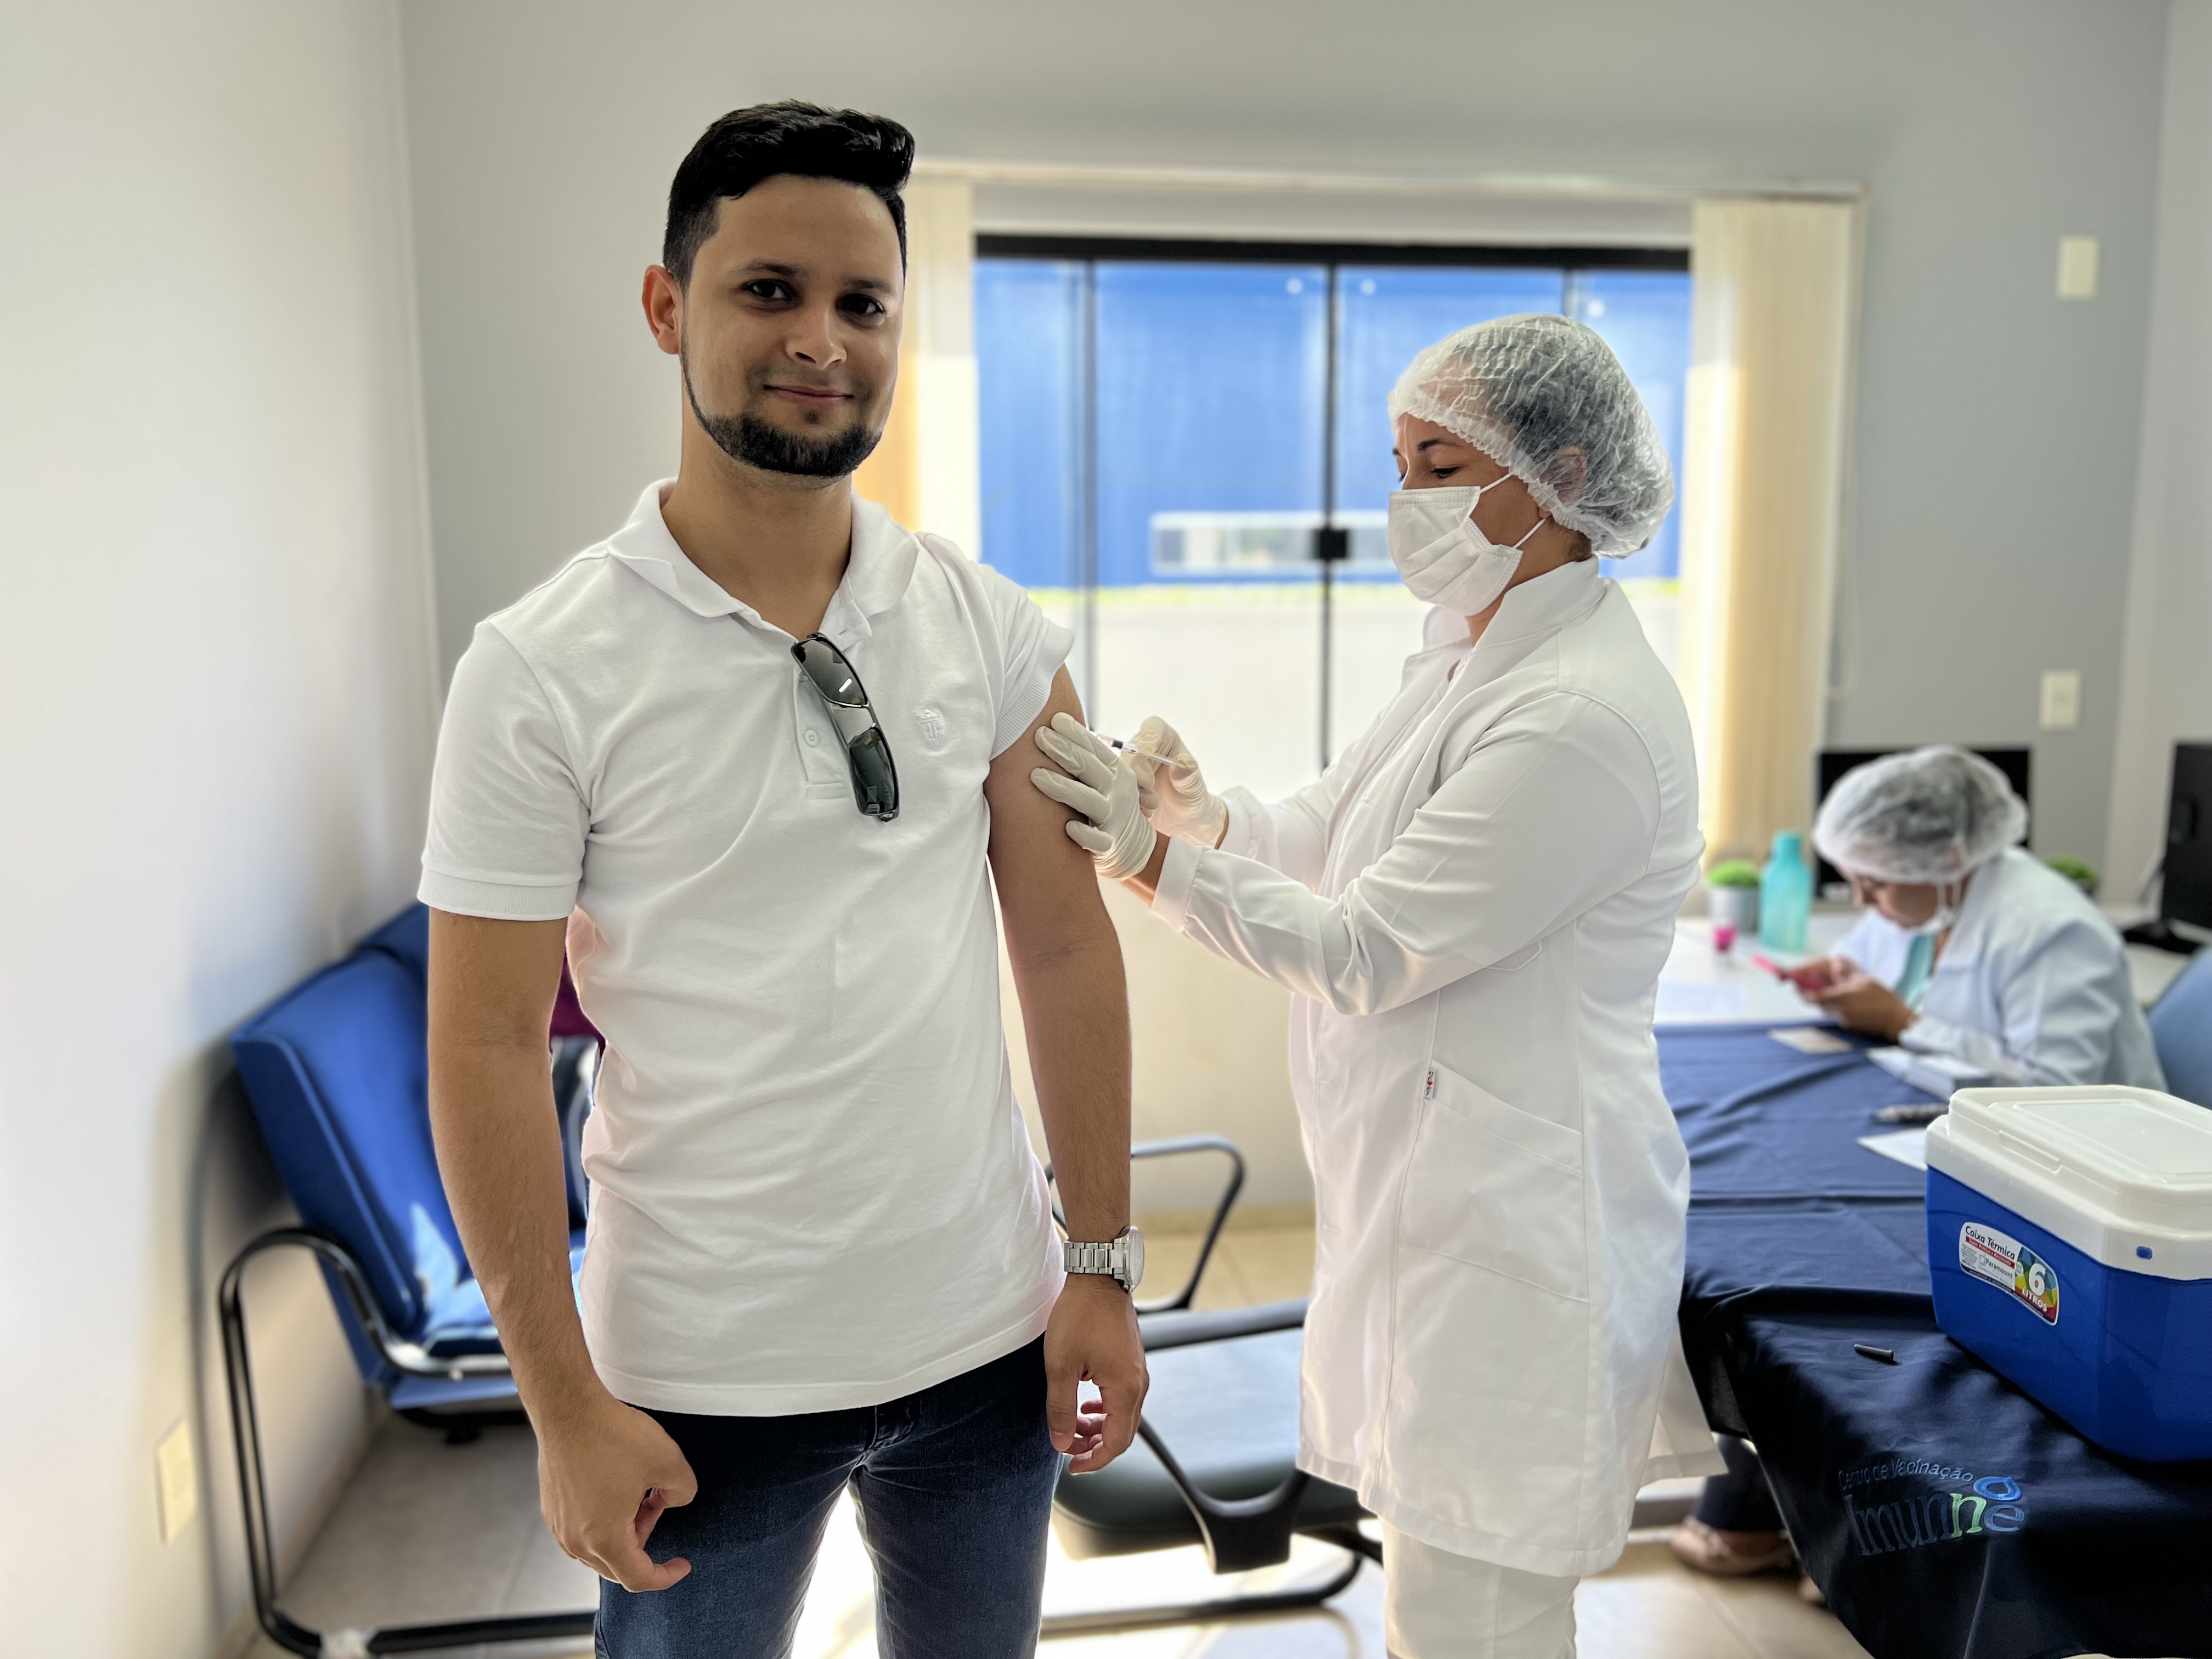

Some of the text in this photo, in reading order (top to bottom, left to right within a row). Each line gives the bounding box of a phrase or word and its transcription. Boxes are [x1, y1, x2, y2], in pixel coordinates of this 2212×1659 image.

[1966, 1226, 1985, 1243] Caixa
[1988, 1237, 2015, 1260] Térmica
[1986, 1258, 2013, 1279] Paramount
[2029, 1263, 2046, 1296] 6
[2022, 1286, 2047, 1312] LITROS
[1838, 1470, 1870, 1491] Centro
[1873, 1462, 1888, 1481] de
